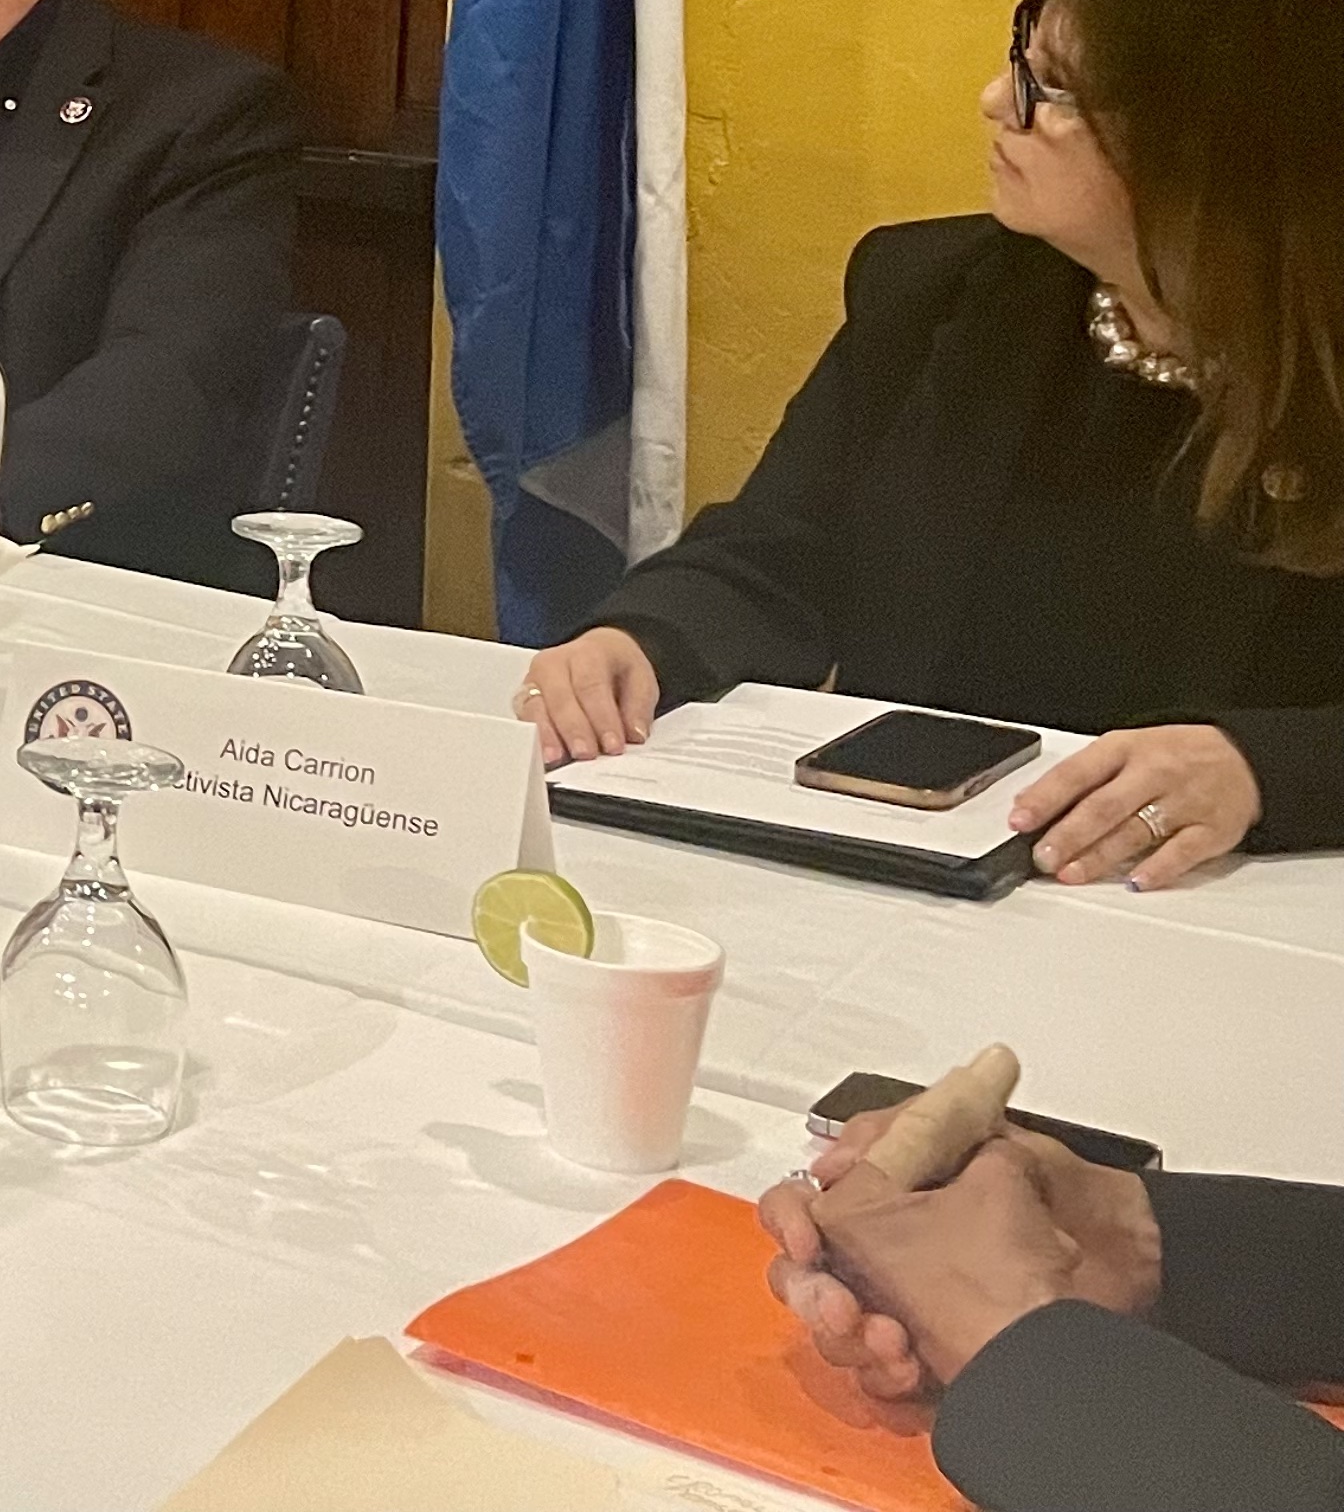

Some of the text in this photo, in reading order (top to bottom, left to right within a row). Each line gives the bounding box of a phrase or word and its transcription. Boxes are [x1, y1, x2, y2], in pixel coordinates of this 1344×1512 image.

[220, 737, 375, 785] Aida Carrion
[172, 770, 439, 837] tivista Nicaragüense
